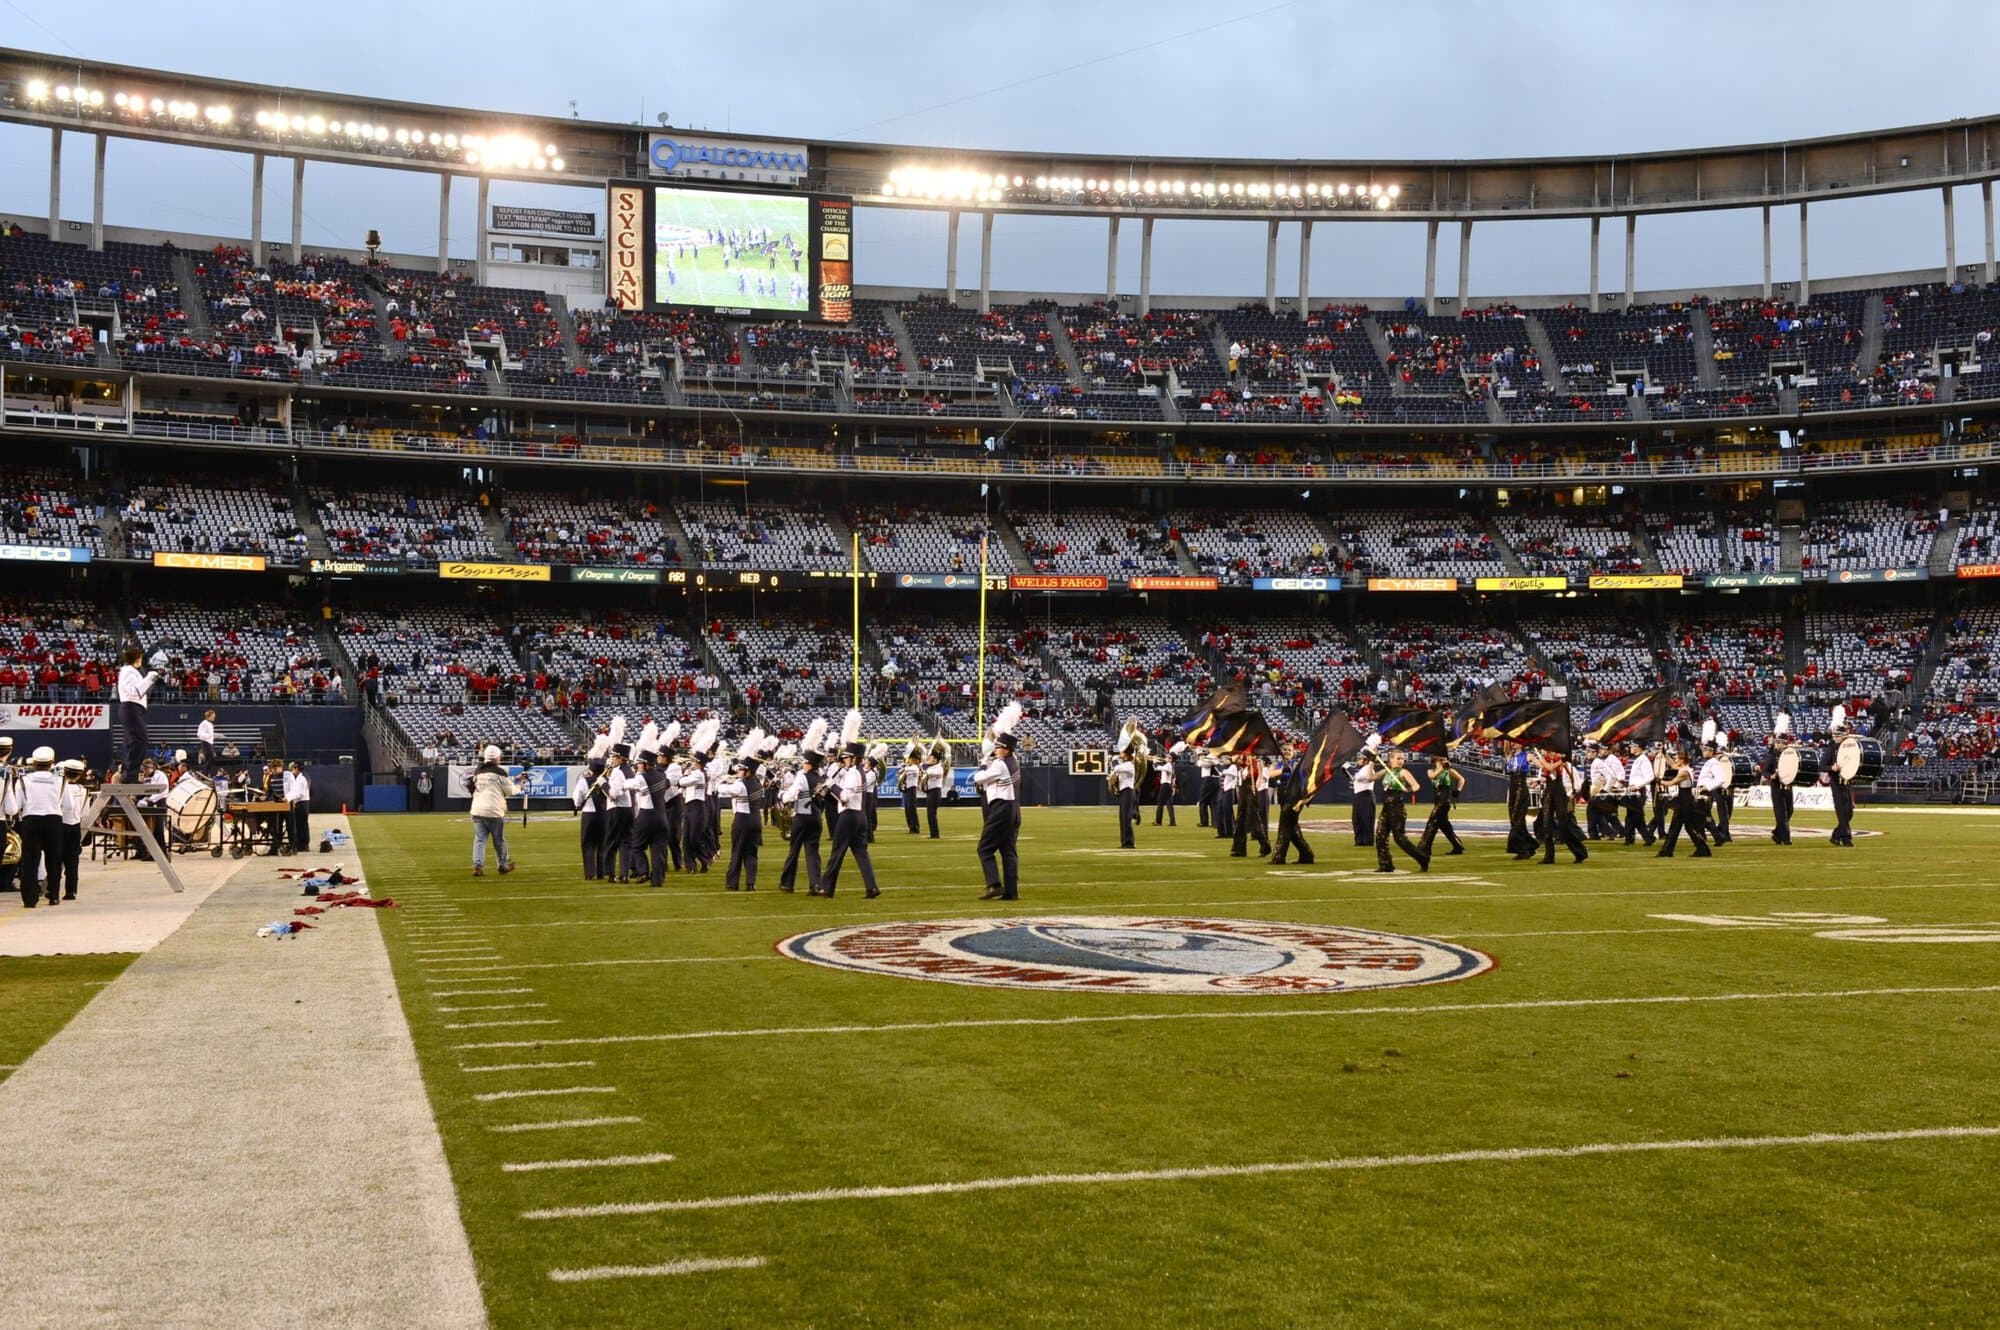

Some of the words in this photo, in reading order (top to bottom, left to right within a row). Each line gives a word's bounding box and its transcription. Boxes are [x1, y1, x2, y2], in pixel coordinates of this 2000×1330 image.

[651, 138, 808, 174] QUALCOMM
[686, 168, 798, 183] STADIUM
[617, 193, 637, 306] SYCUAN
[820, 290, 852, 298] LIGHT
[0, 545, 71, 561] GEICO
[166, 553, 254, 570] CYMER
[324, 559, 366, 573] Brigantine
[495, 566, 540, 578] Pizza
[585, 570, 614, 580] Degree
[627, 571, 656, 581] Degree
[696, 574, 704, 585] 0
[740, 573, 760, 584] NEB
[771, 576, 778, 586] 0
[871, 578, 875, 588] 1
[1014, 577, 1058, 587] WELLS
[1060, 578, 1102, 588] FARGO
[1271, 578, 1327, 590] GEICO
[1377, 578, 1448, 591] CYMER
[1719, 577, 1748, 586] Degree
[1767, 576, 1796, 585] Degree
[997, 580, 1008, 591] 15
[18, 705, 103, 717] HALFTIME
[39, 717, 94, 729] SHOW
[1075, 751, 1102, 773] 25
[546, 785, 566, 796] LIFE
[881, 785, 899, 795] LIFE
